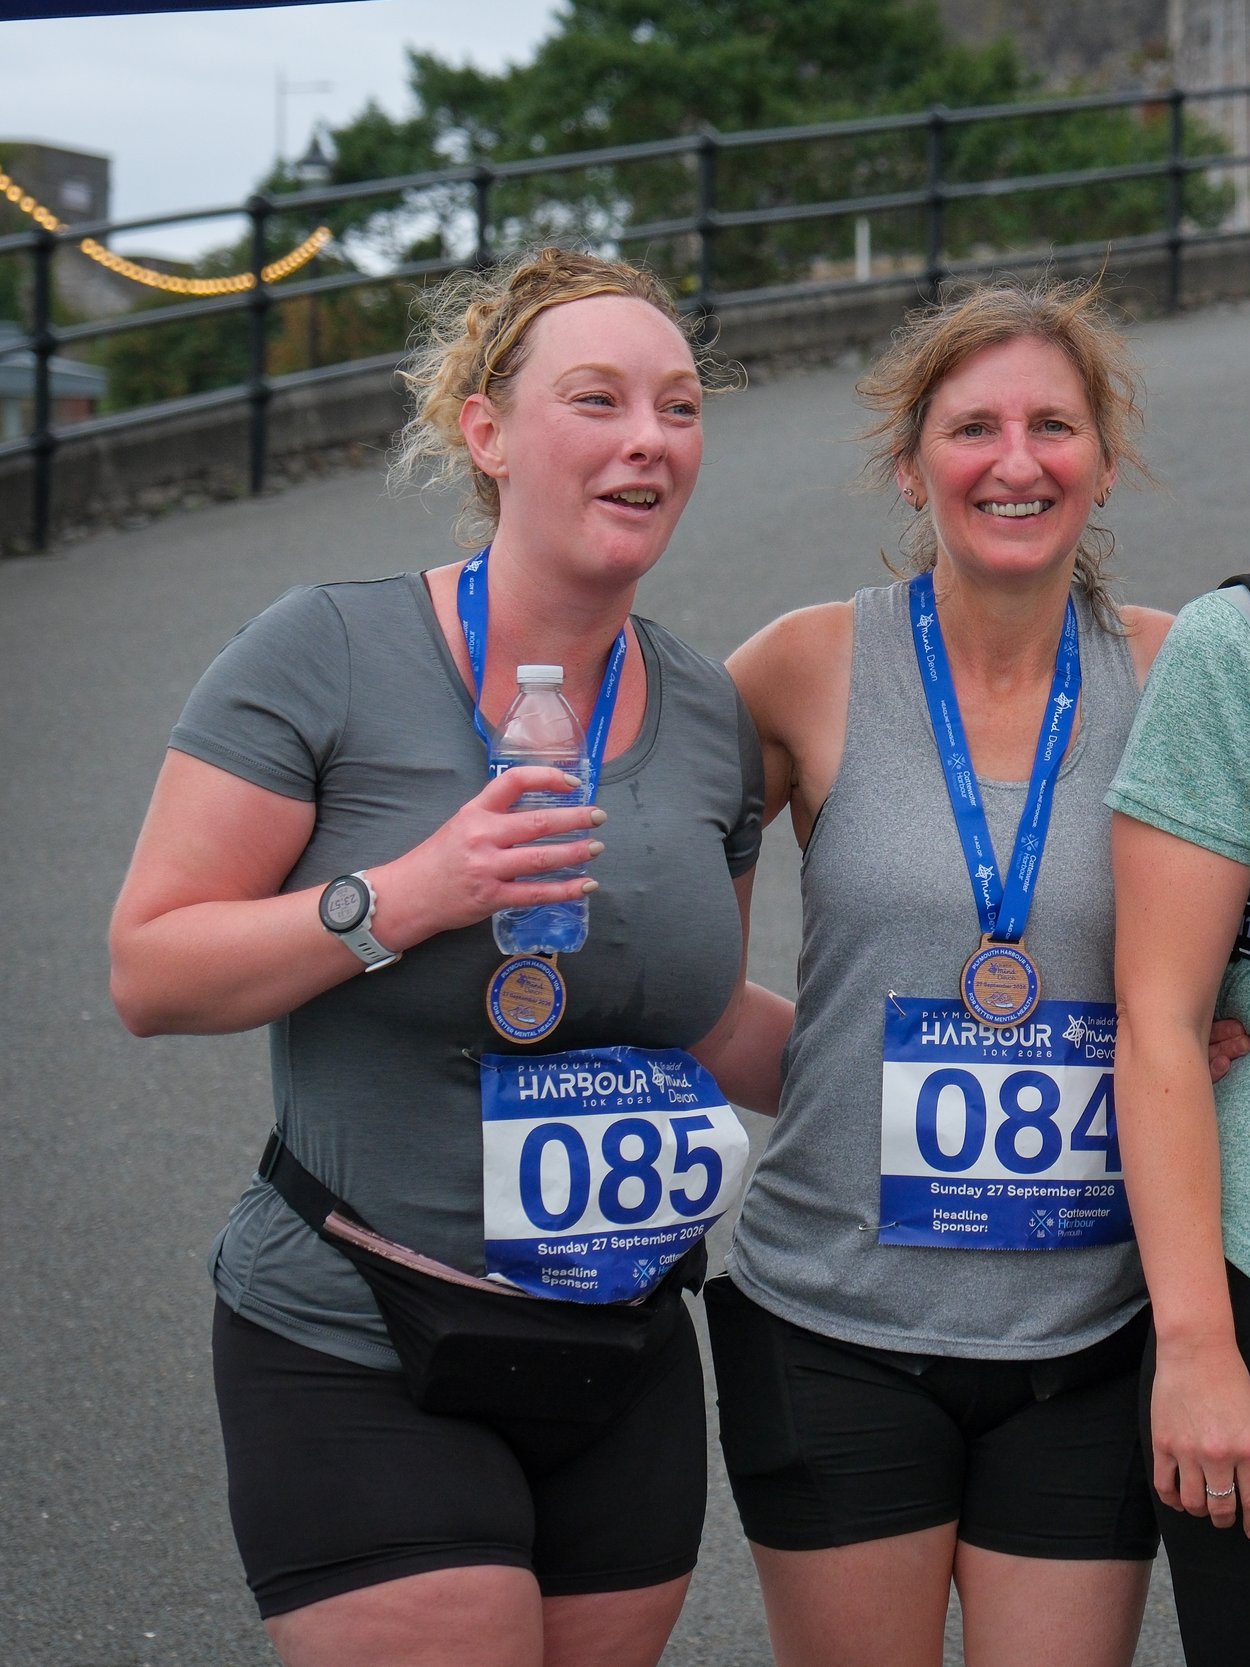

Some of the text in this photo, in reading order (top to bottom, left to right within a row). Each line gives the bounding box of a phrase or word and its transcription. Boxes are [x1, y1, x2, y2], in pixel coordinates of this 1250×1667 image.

[921, 627, 937, 682] mind Devon
[1044, 707, 1063, 761] mind Devon
[956, 772, 967, 799] Harbour
[963, 770, 976, 807] Cattewater
[1018, 852, 1029, 880] Harbour
[1023, 854, 1037, 892] Cattewater
[981, 878, 995, 909] mind
[501, 960, 530, 978] PLYMOUTH
[532, 962, 556, 981] HARBOUR
[972, 949, 1033, 974] PLYMOUTH HARBOUR 10K
[968, 992, 976, 1005] FOR
[975, 1005, 993, 1020] BETTER
[1017, 997, 1033, 1017] HEALTH
[497, 1015, 514, 1033] BETTER
[538, 1015, 555, 1033] HEALTH
[1088, 1016, 1115, 1026] In aid of
[922, 1022, 1052, 1047] HARBOUR
[1086, 1029, 1116, 1043] min
[518, 1062, 601, 1073] PLYMOUTH
[519, 1070, 649, 1100] HARBOUR
[665, 1073, 692, 1088] mind
[583, 1097, 652, 1107] 10K 2026
[668, 1089, 698, 1103] Devon
[916, 1068, 1122, 1174] 084
[519, 1114, 722, 1232] 085
[931, 1183, 1115, 1199] Sunday 27 September 2026
[933, 1209, 988, 1221] Headline
[1058, 1208, 1110, 1217] Cattewater
[933, 1221, 988, 1233] Sponsor:
[1058, 1219, 1095, 1228] Harbour
[1058, 1229, 1082, 1237] Plymouth
[538, 1225, 704, 1255] Sunday 27 September 2026
[542, 1267, 598, 1277] Headline
[542, 1275, 598, 1289] Sponsor:
